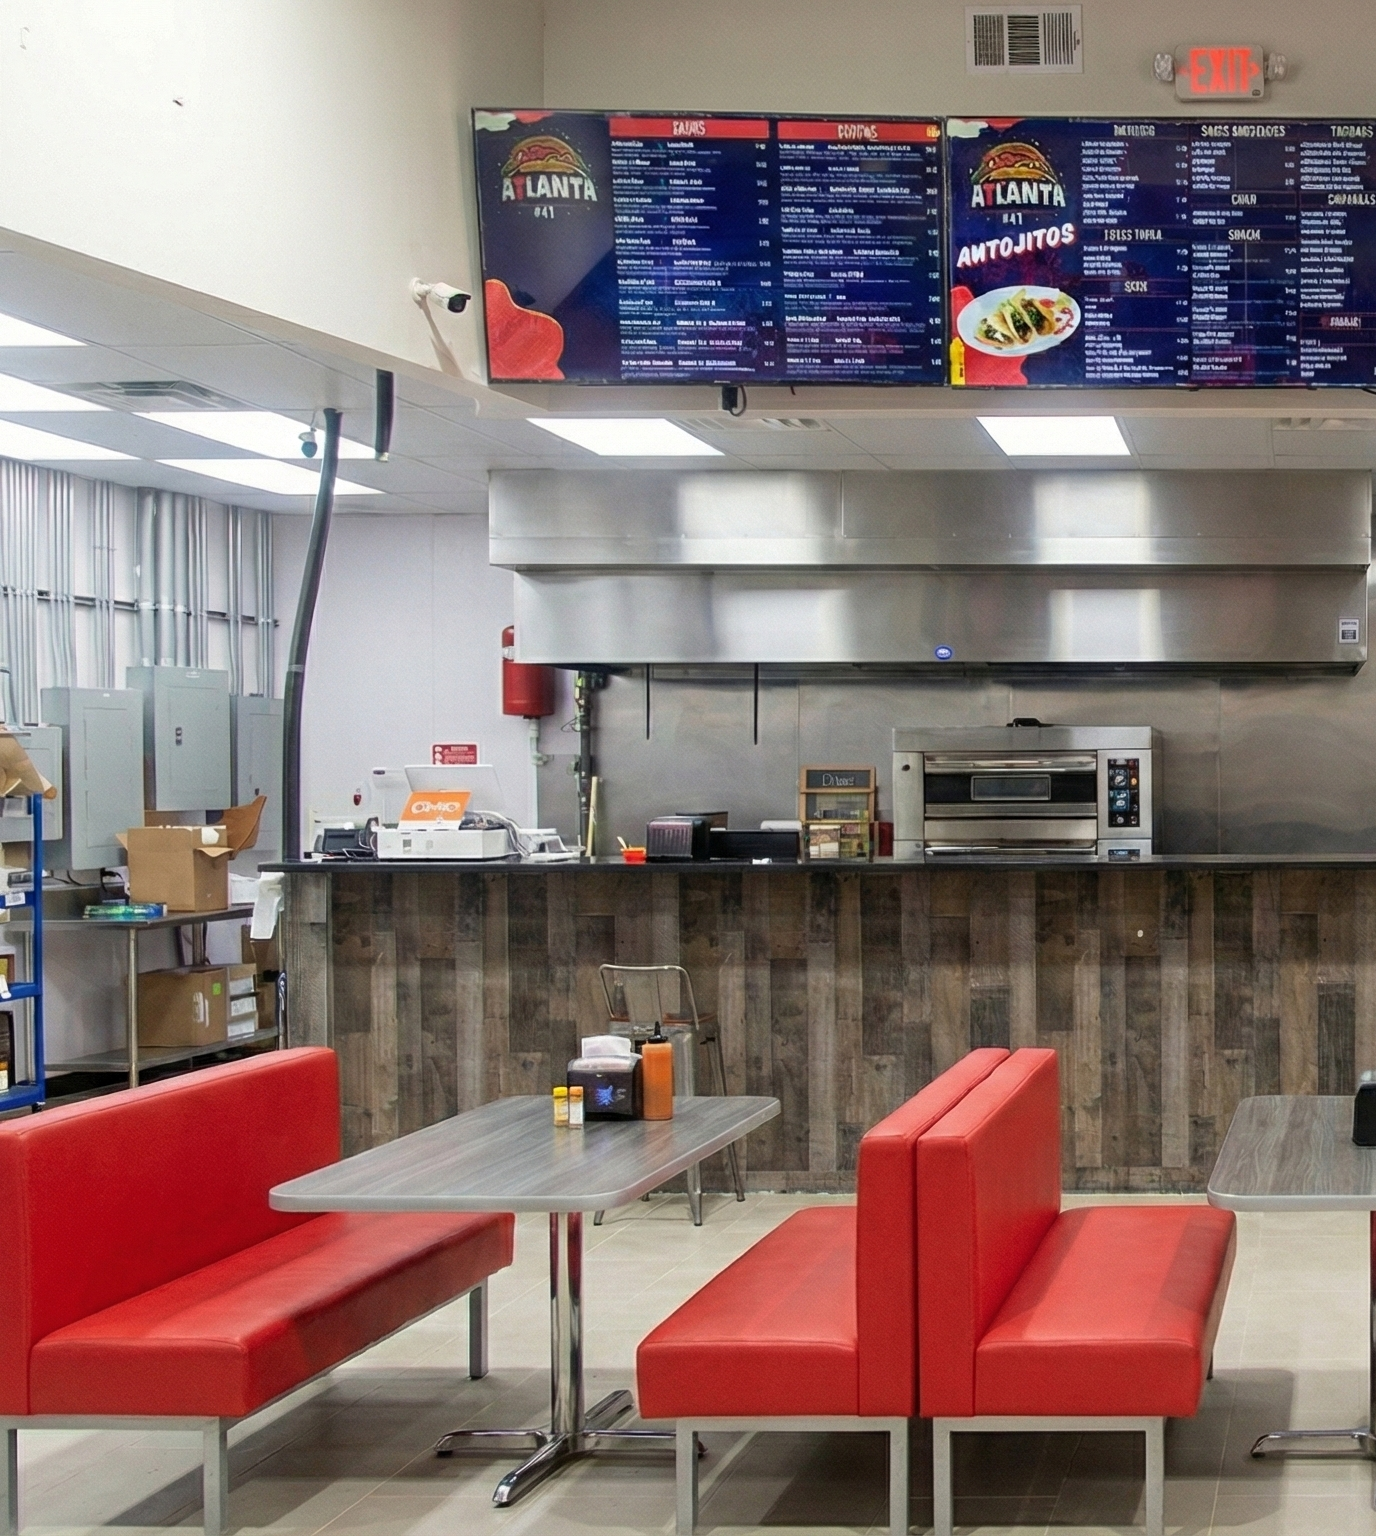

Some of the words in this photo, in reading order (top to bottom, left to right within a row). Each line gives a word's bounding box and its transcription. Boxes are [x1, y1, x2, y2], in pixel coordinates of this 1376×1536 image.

[1189, 47, 1251, 94] EXIT
[502, 174, 598, 202] ATLANTA
[971, 181, 1066, 208] ATLANTA
[956, 222, 1076, 268] ANTOJITOS
